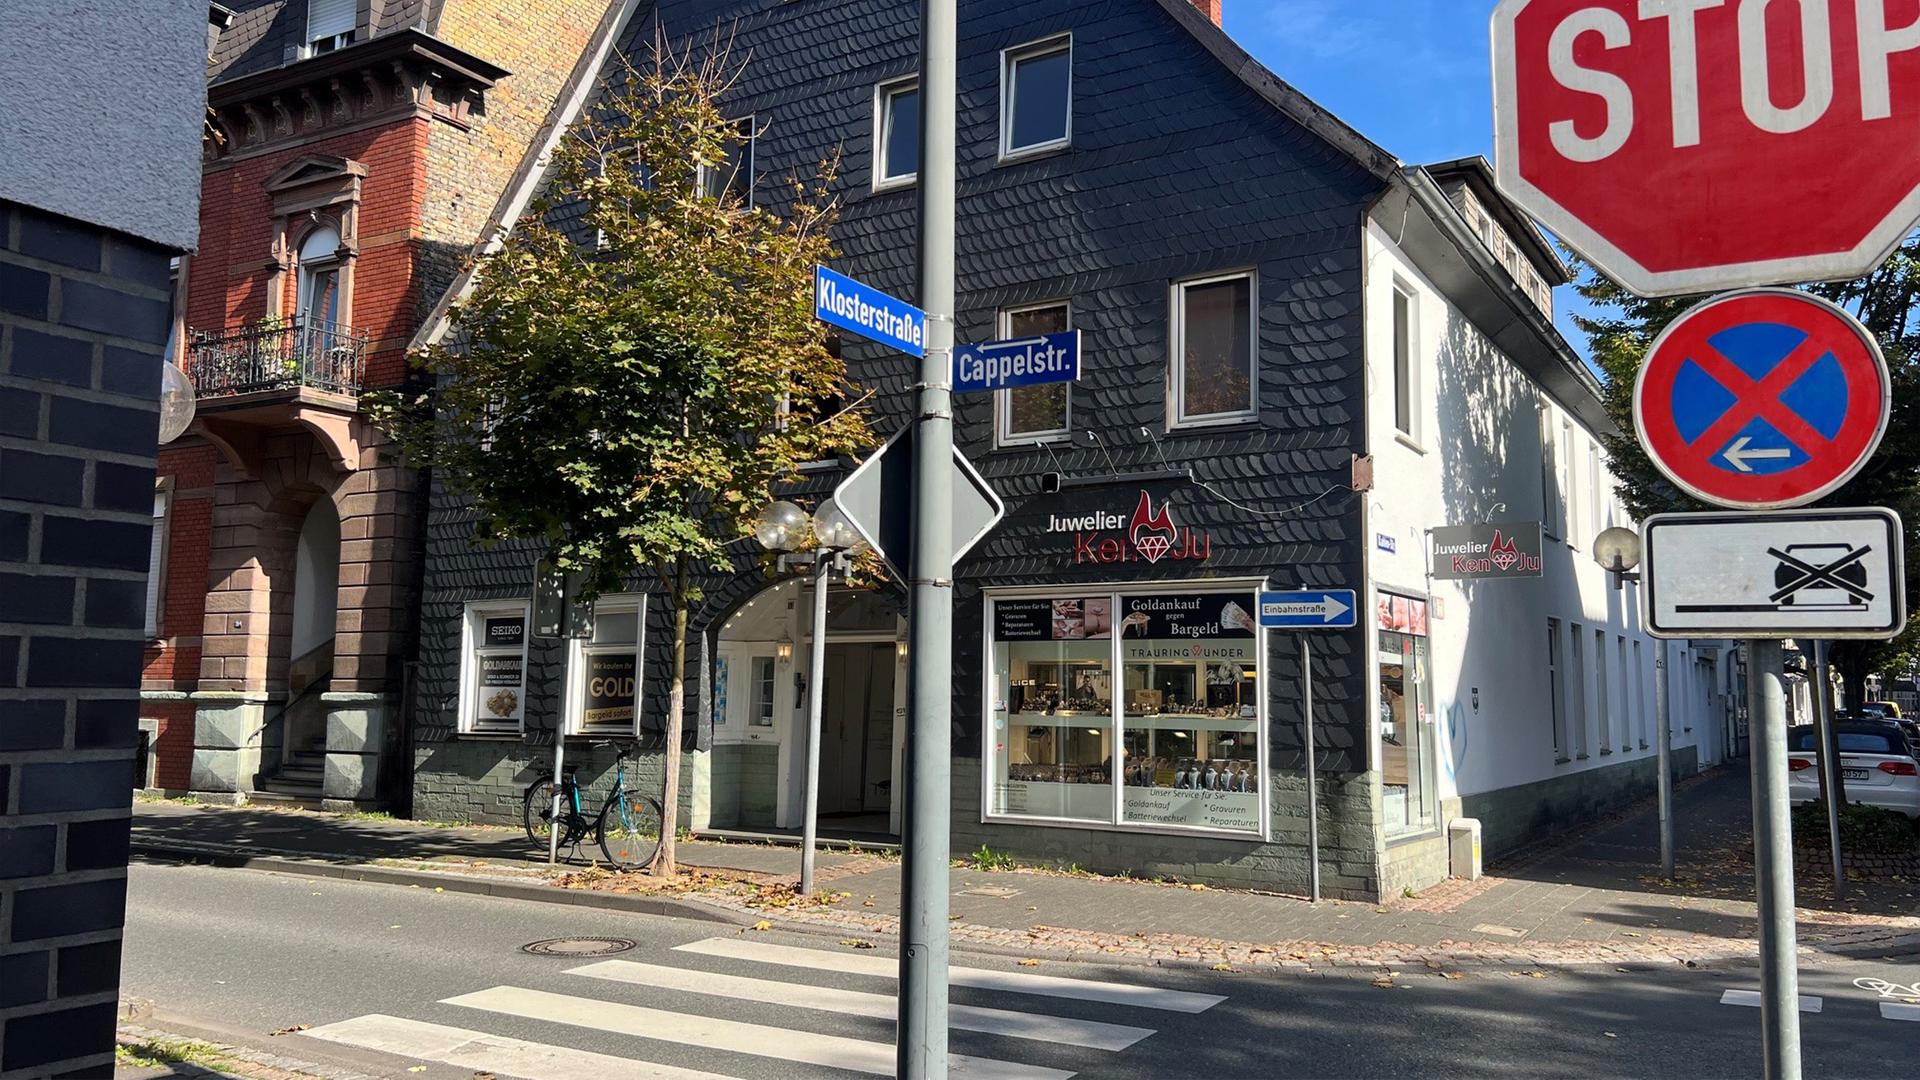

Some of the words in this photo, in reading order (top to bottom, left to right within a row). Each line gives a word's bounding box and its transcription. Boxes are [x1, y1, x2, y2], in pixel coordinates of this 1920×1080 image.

[819, 276, 921, 347] Klosterstraße
[959, 346, 1071, 387] Cappelstr.
[1046, 511, 1126, 533] Juwelier
[1074, 531, 1138, 565] Ken
[1172, 526, 1213, 561] Ju
[1434, 541, 1488, 556] Juwelier
[1451, 555, 1491, 574] Ken
[1517, 552, 1540, 571] Ju
[1131, 598, 1202, 611] Goldankauf
[1264, 604, 1326, 614] Einbahnstraße
[491, 625, 522, 635] SEIKO
[1171, 622, 1219, 638] Bargeld
[590, 677, 635, 697] GOLD
[1150, 789, 1171, 798] Unser
[1173, 789, 1200, 799] Service
[1200, 790, 1213, 800] für
[1128, 800, 1170, 811] Goldankauf
[1210, 804, 1246, 814] Gravuren
[1128, 811, 1187, 823] Batteriewechsel
[1210, 817, 1259, 827] Reparaturen
